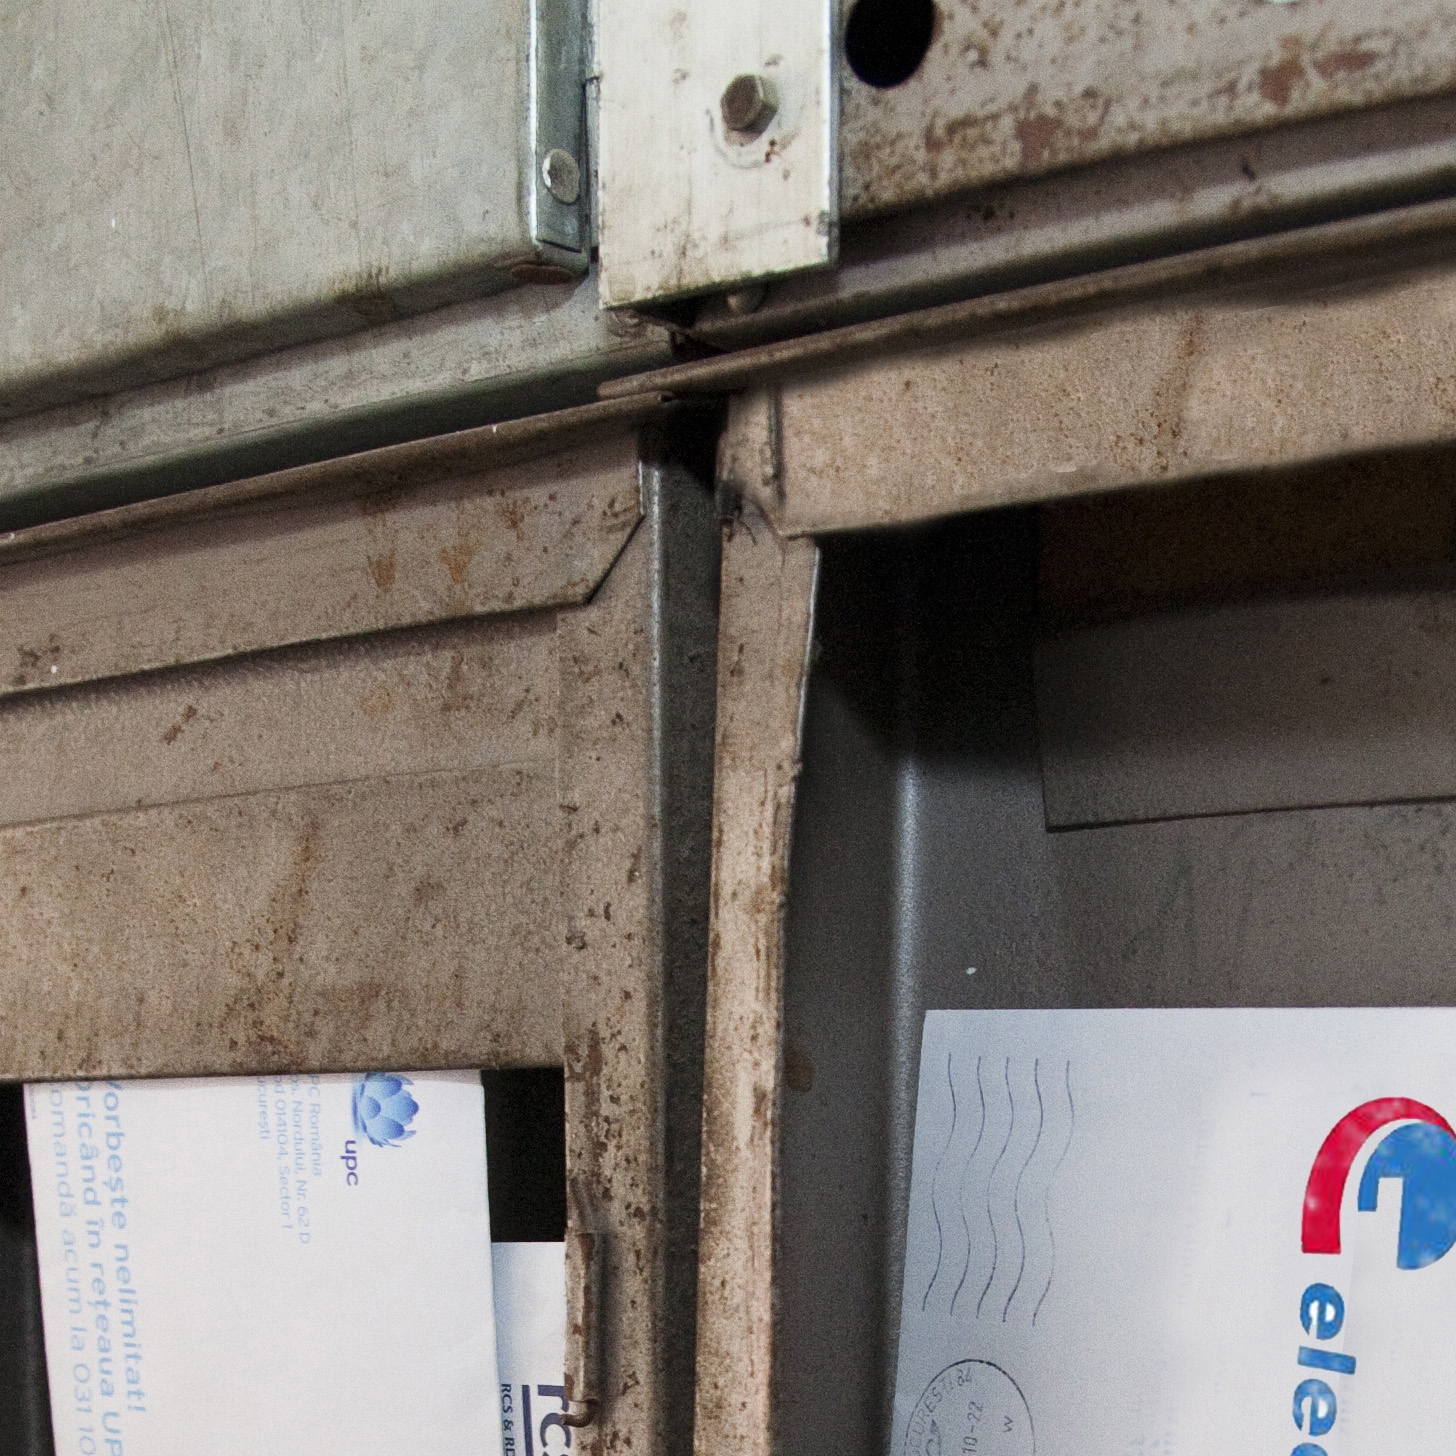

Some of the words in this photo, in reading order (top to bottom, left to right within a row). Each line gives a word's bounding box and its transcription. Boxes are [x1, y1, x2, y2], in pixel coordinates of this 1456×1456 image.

[307, 1074, 322, 1098] PC
[340, 1140, 359, 1187] upc
[86, 1218, 104, 1248] în
[61, 1229, 84, 1315] acum
[70, 1325, 87, 1352] la
[113, 1242, 146, 1412] nelimitat!
[73, 1363, 93, 1414] 031
[501, 1383, 514, 1414] RCS
[503, 1419, 515, 1431] &
